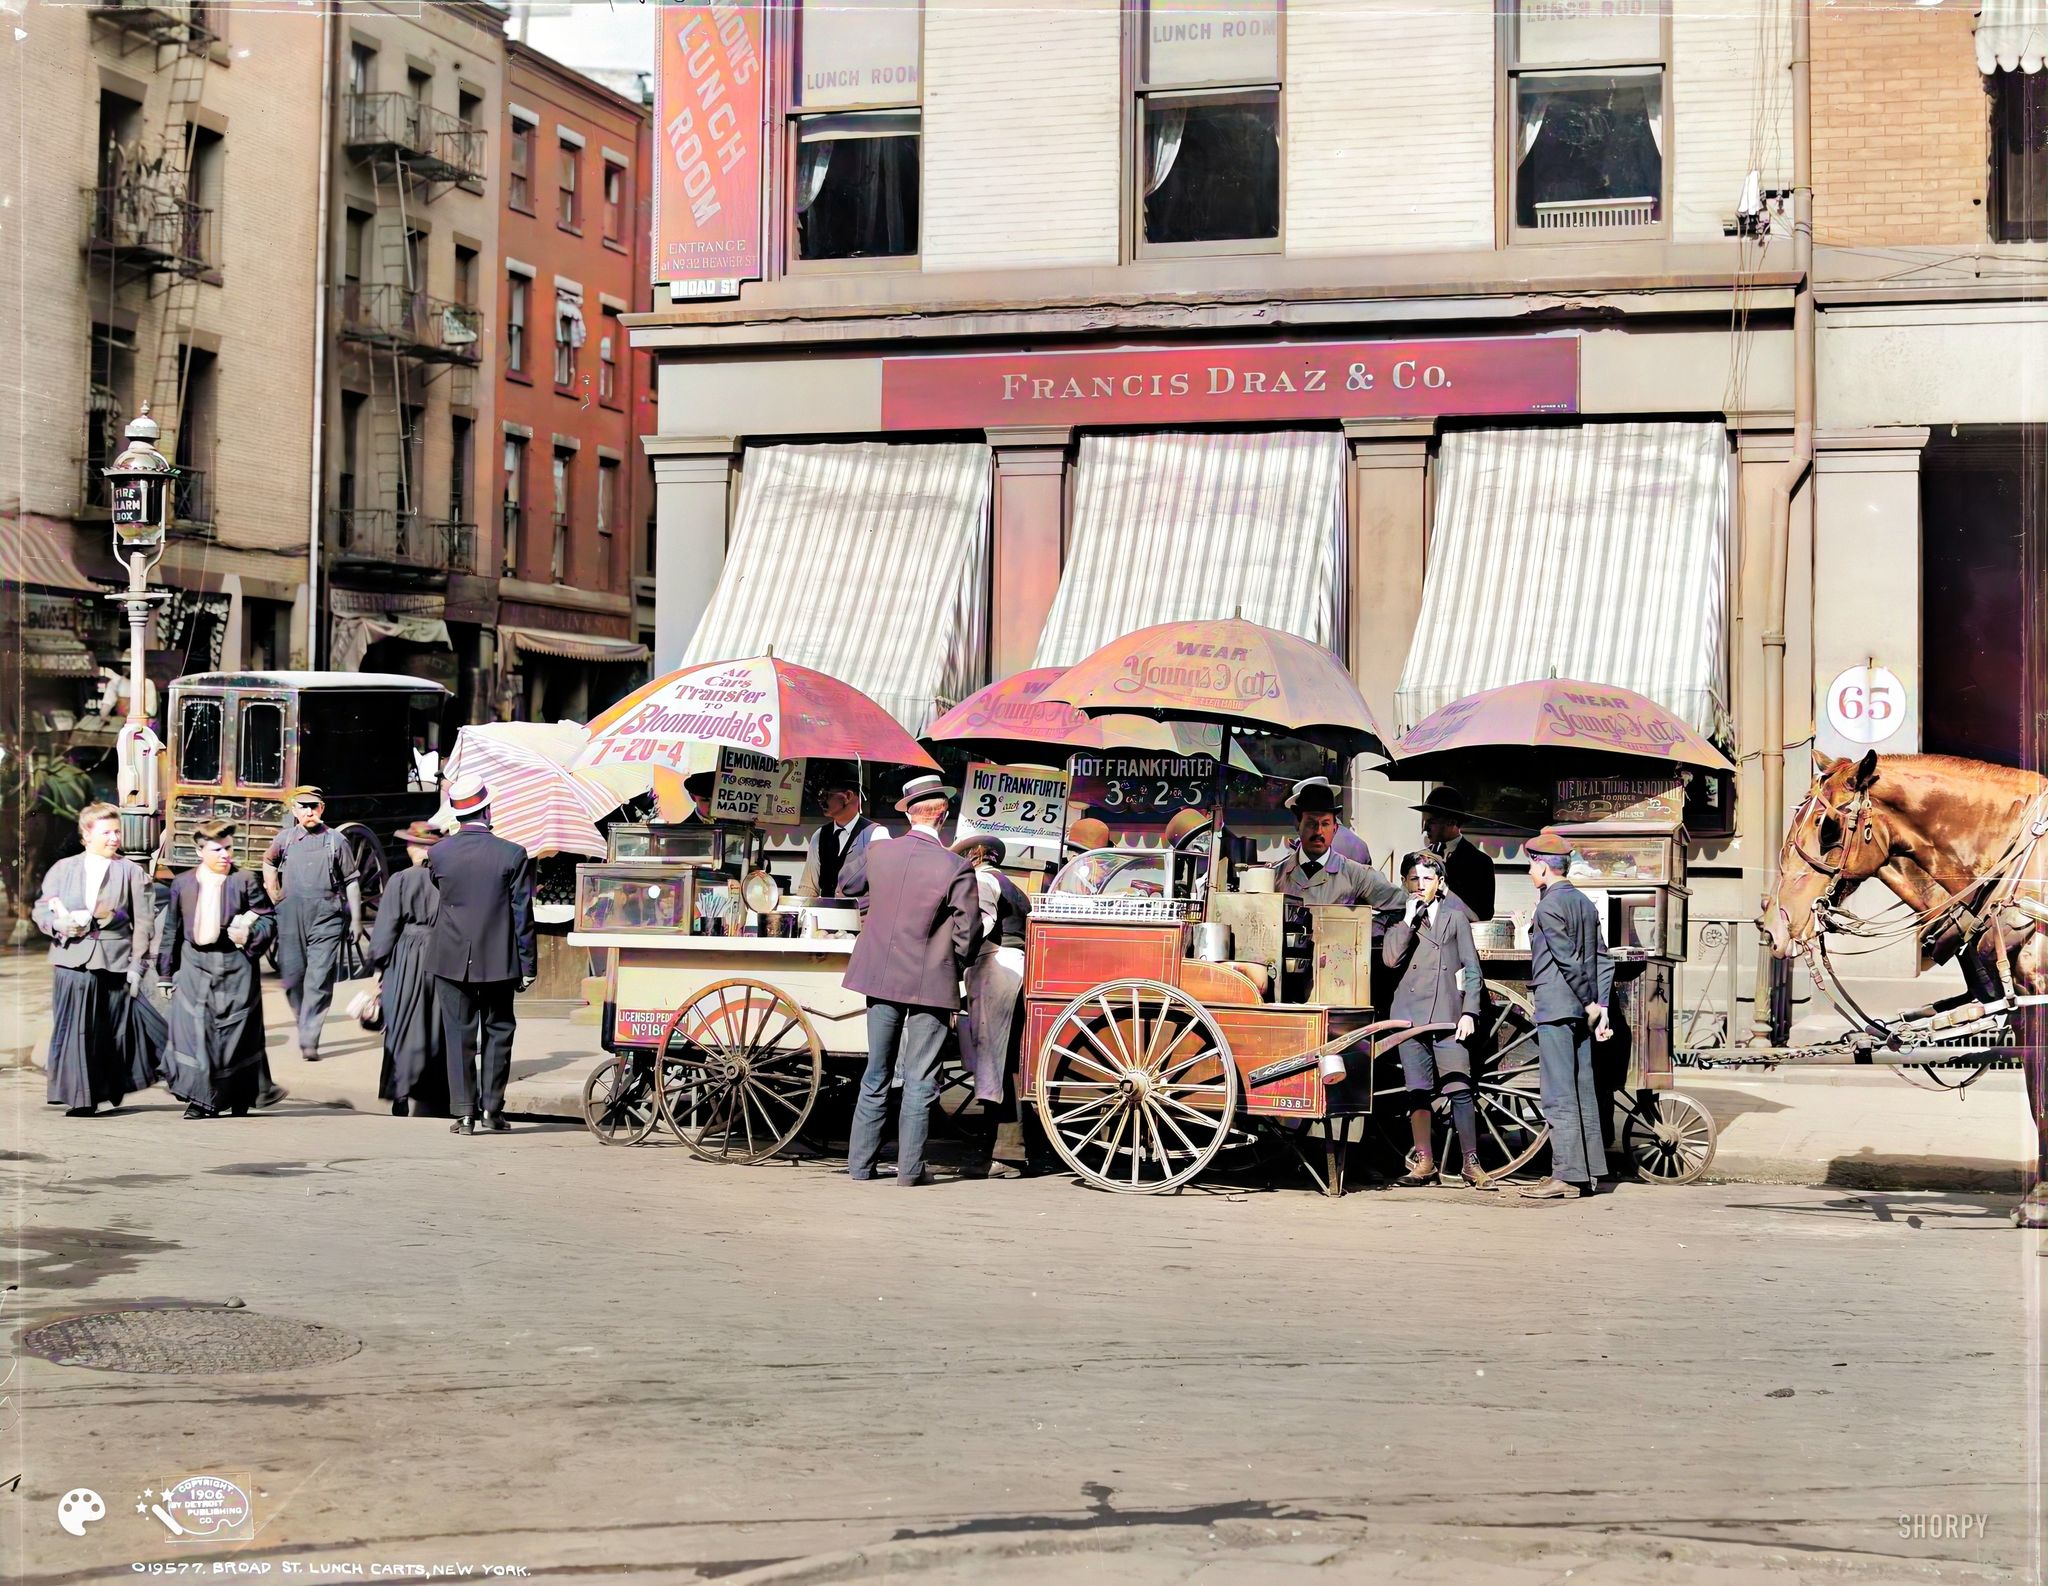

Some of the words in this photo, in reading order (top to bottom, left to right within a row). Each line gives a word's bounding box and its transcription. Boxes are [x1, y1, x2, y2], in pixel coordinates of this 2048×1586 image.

[1152, 23, 1211, 43] LUNCH
[1222, 20, 1276, 38] ROOM
[807, 70, 860, 90] LUNCH
[678, 14, 747, 176] LUNCH
[666, 106, 721, 228] ROOM
[669, 240, 746, 255] ENTRANCE
[1002, 373, 1190, 401] FRANCIS
[1206, 367, 1327, 394] DRAZ
[1346, 362, 1374, 391] &
[116, 512, 133, 521] BOX
[1175, 642, 1248, 662] WEAR
[704, 676, 753, 688] Cars
[674, 684, 768, 704] Transfer
[1563, 692, 1630, 710] WEAR
[1838, 686, 1892, 720] 65
[720, 745, 780, 774] LEMONADE
[973, 769, 997, 791] HOT
[1576, 780, 1600, 798] REAL
[718, 788, 762, 802] READY
[717, 802, 759, 814] MADE
[1020, 800, 1036, 822] 2
[618, 1011, 655, 1023] LICENSED
